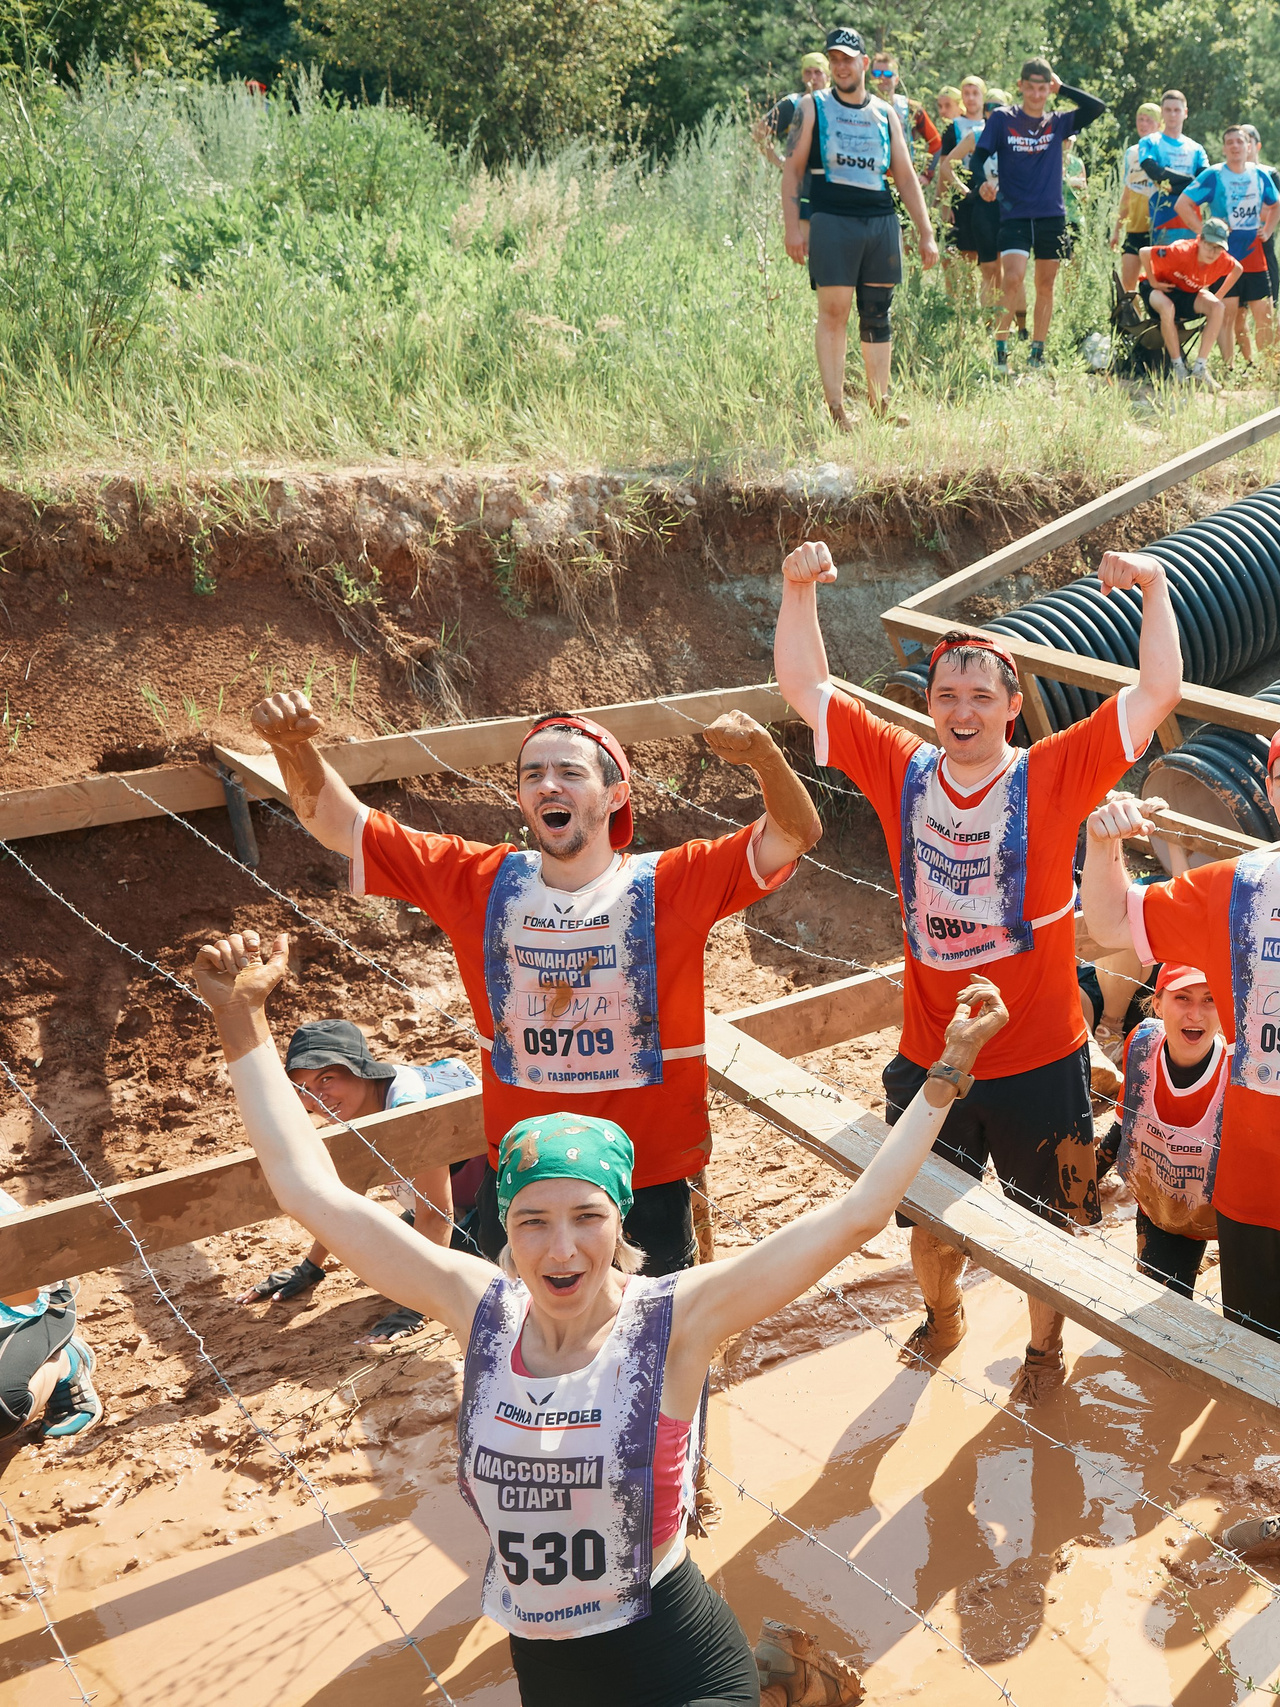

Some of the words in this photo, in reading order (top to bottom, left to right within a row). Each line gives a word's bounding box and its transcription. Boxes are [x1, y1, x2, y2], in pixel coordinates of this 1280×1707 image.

[1232, 205, 1258, 219] 5844
[927, 815, 951, 838] ГОНКА
[953, 831, 990, 842] ГЕРОЕВ
[916, 842, 989, 880] КОМАНДНЫЙ
[932, 869, 967, 895] СТАРТ
[523, 915, 556, 929] ГОНКА
[560, 914, 610, 929] ГЕРОЕВ
[517, 944, 615, 970] КОМАНДНЫЙ
[942, 940, 996, 961] ГАЗПРОМБАНК
[541, 970, 586, 988] СТАРТ
[523, 1028, 614, 1057] 09709
[547, 1069, 620, 1082] ГАЗПРОМБАНК
[1166, 1143, 1202, 1153] ГЕРОЕВ
[1143, 1144, 1203, 1179] КОМАНДНЫЙ
[1157, 1166, 1183, 1188] СТАРТ
[496, 1401, 532, 1425] ГОНКА
[534, 1408, 602, 1426] ГЕРОЕВ
[477, 1452, 597, 1485] МАССОВЫЙ
[501, 1486, 565, 1509] СТАРТ
[498, 1529, 606, 1586] 530
[514, 1600, 601, 1623] ГАЗПРОМБАНК
